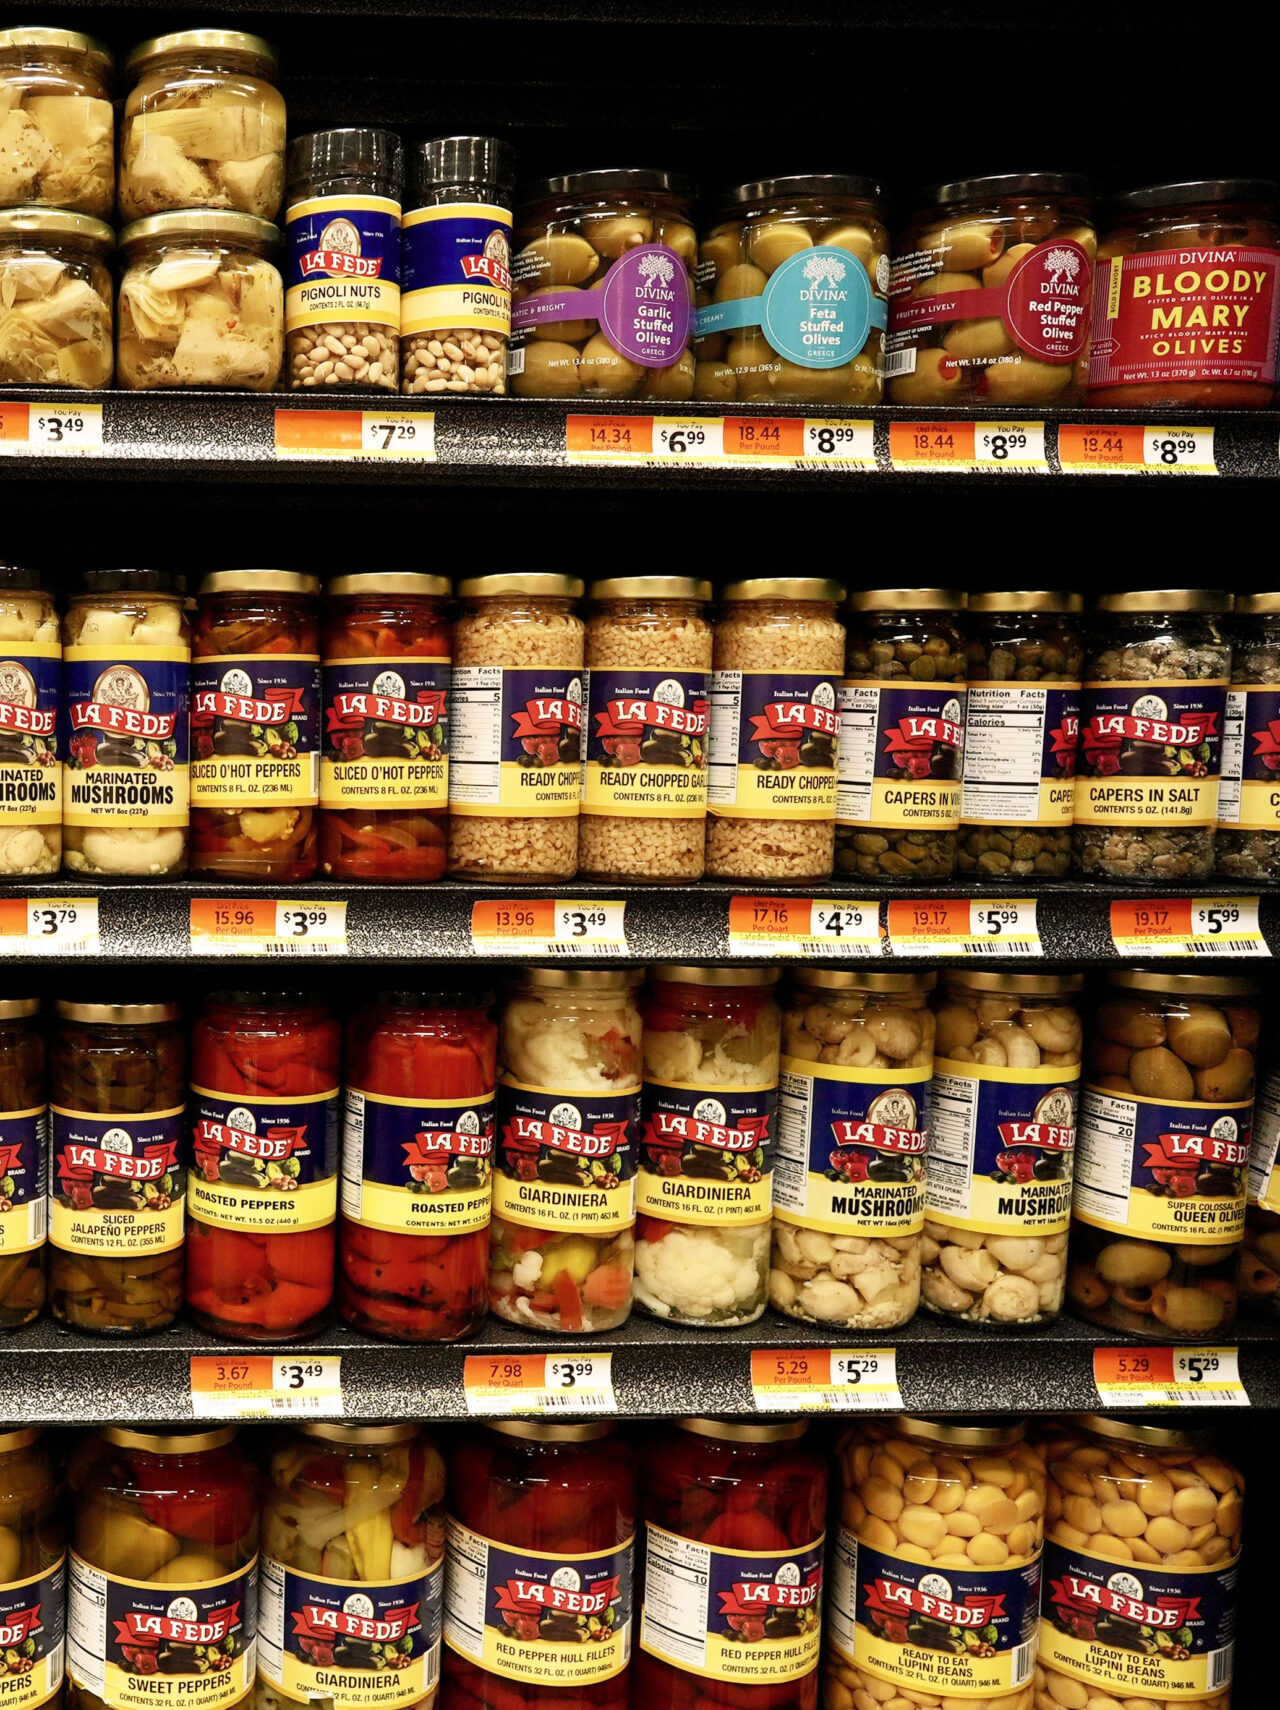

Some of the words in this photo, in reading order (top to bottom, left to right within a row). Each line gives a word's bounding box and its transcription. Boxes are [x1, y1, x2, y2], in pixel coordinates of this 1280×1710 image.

[304, 255, 327, 270] LA
[331, 255, 377, 275] FEDE
[1180, 251, 1235, 265] DIVINA
[1040, 282, 1079, 296] DIVINA
[1133, 270, 1267, 298] BLOODY
[301, 287, 346, 301] PIGNOLI
[350, 287, 381, 299] NUTS
[635, 287, 674, 301] DIVINA
[800, 289, 845, 302] DIVINA
[637, 305, 672, 320] Garlic
[810, 308, 836, 320] Feta
[896, 308, 919, 319] FRUITY
[920, 306, 926, 314] &
[929, 302, 956, 313] LIVELY
[1029, 301, 1052, 313] Red
[1055, 301, 1083, 316] Pepper
[1040, 313, 1076, 327] Stuffed
[1151, 305, 1250, 330] MARY
[633, 318, 673, 332] Stuffed
[800, 319, 844, 333] Stuffed
[636, 332, 671, 345] Olives
[802, 333, 841, 346] Olives
[1042, 327, 1073, 339] Olives
[641, 348, 665, 356] GREECE
[1152, 338, 1243, 356] OLIVES
[548, 359, 559, 367] Net
[559, 359, 570, 367] Wt.
[572, 358, 585, 366] 13.4
[596, 358, 609, 366] (380
[611, 358, 618, 366] g)
[590, 428, 632, 443] 14.34
[738, 426, 780, 441] 18.44
[970, 689, 1010, 698] Nutrition
[1020, 690, 1045, 699] Facts
[968, 718, 1005, 727] Calories
[1097, 717, 1125, 734] LA
[1135, 720, 1200, 743] FEDE
[85, 772, 157, 785] MARINATED
[333, 766, 367, 780] SLICED
[371, 765, 405, 780] O'HOT
[408, 765, 444, 779] PEPPERS
[600, 772, 636, 786] READY
[639, 772, 689, 787] CHOPPED
[71, 785, 174, 804] MUSHROOMS
[1090, 788, 1144, 802] CAPERS
[1148, 789, 1163, 801] IN
[1168, 788, 1199, 801] SALT
[496, 912, 535, 926] 13.96
[753, 909, 788, 923] 17.16
[914, 911, 947, 925] 19.17
[519, 1186, 608, 1207] GIARDINIERA
[853, 1185, 917, 1199] MARINATED
[103, 1214, 135, 1225] SLICED
[1174, 1209, 1215, 1223] QUEEN
[71, 1223, 120, 1236] JALAPEÑO
[124, 1223, 165, 1236] PEPPERS
[217, 1366, 249, 1380] 3.67
[776, 1360, 808, 1374] 5.29
[1070, 1578, 1101, 1603] LA
[1110, 1594, 1179, 1627] FEDE
[496, 1642, 515, 1657] RED
[518, 1645, 558, 1663] PEPPER
[560, 1648, 583, 1663] HULL
[586, 1646, 615, 1662] FILLETS
[902, 1647, 935, 1663] READY
[937, 1654, 949, 1665] TO
[952, 1655, 969, 1666] EAT
[898, 1656, 935, 1674] LUPINI
[937, 1663, 973, 1678] BEANS
[315, 1672, 400, 1690] GIARDINIERA
